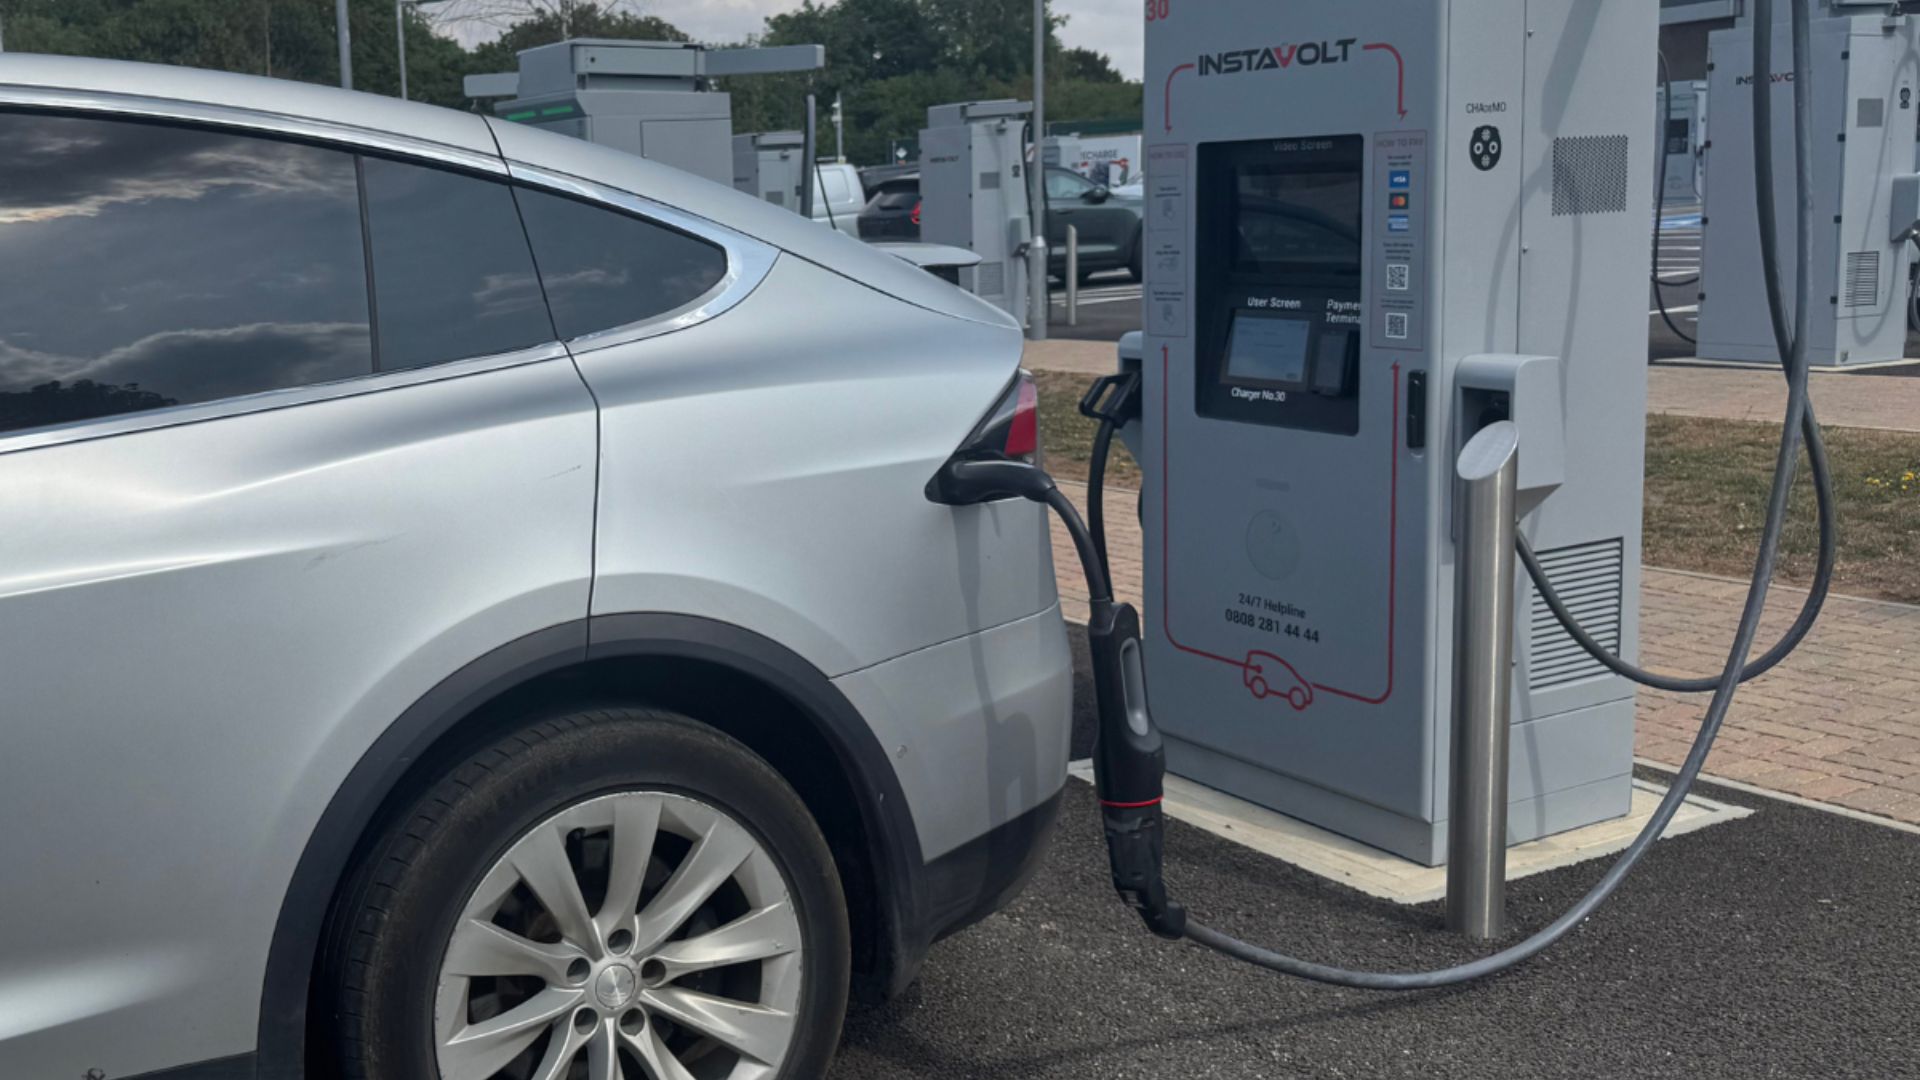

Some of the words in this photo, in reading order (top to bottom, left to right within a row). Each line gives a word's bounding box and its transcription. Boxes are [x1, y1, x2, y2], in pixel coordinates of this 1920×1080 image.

[1146, 0, 1169, 21] 30
[1198, 38, 1357, 76] INSTAVOLT
[1272, 140, 1298, 151] Video
[1300, 139, 1333, 151] Screen
[1247, 296, 1268, 307] User
[1270, 297, 1301, 309] Screen
[1325, 312, 1360, 324] Termina
[1231, 387, 1260, 402] Charger
[1262, 389, 1286, 402] No.30
[1238, 592, 1262, 608] 24/7
[1263, 599, 1306, 618] Helpline
[1225, 608, 1255, 627] 0808
[1258, 616, 1280, 634] 281
[1284, 623, 1300, 638] 44
[1303, 628, 1320, 643] 44
